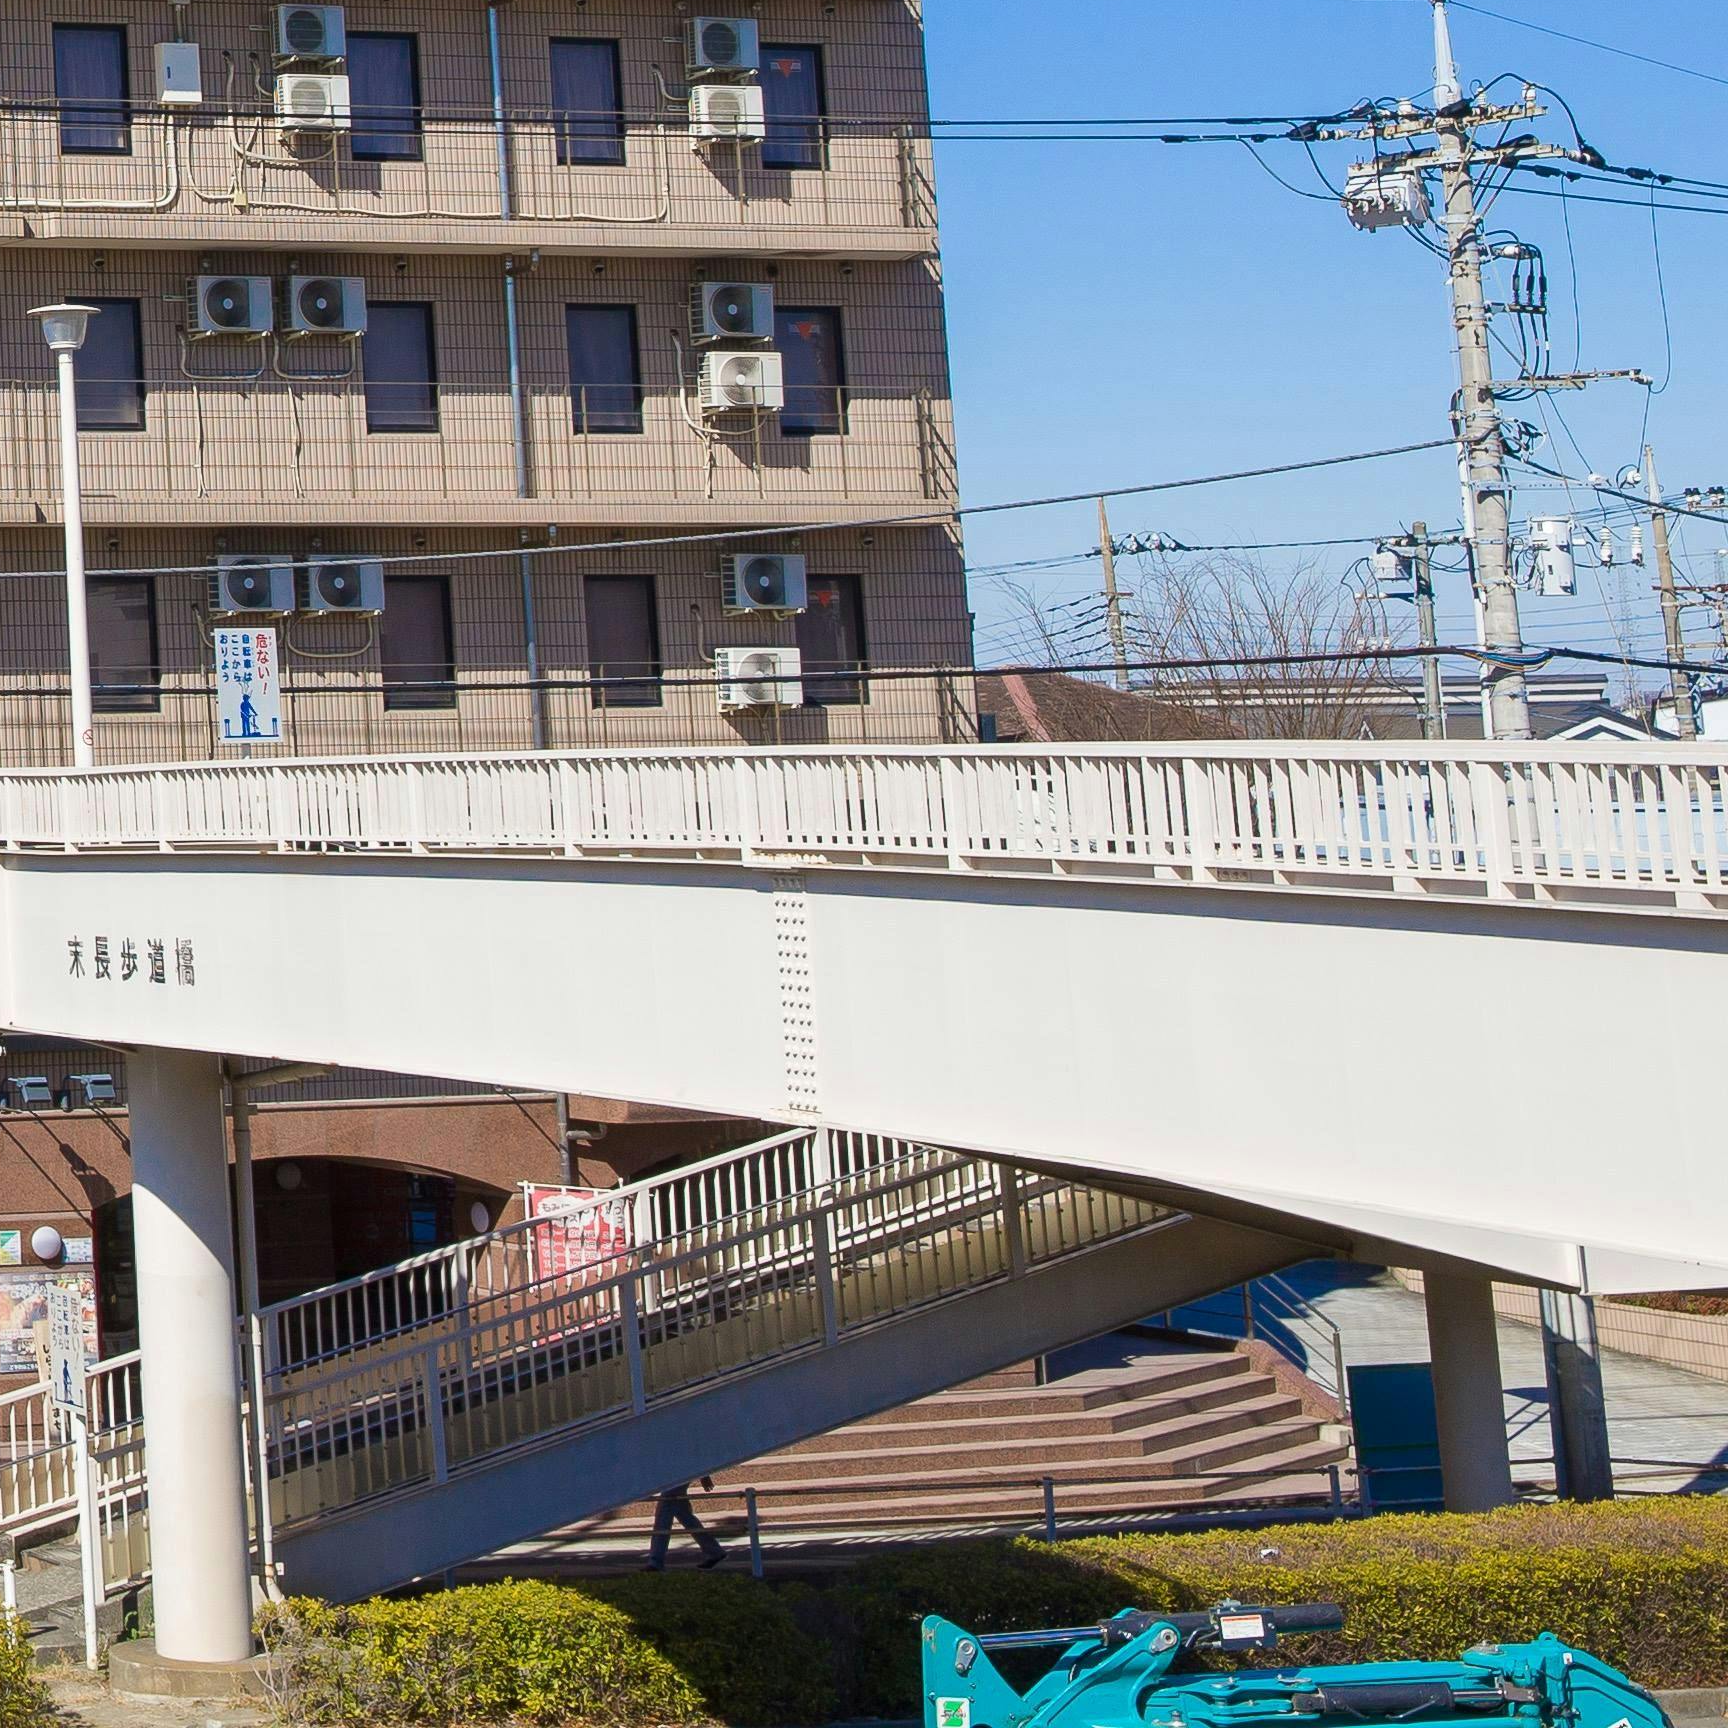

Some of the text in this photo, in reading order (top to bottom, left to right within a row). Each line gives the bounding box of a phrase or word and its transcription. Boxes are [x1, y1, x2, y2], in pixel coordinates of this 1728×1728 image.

[220, 634, 229, 682] おりよう
[231, 634, 241, 682] ここから
[242, 634, 253, 681] 自転車は
